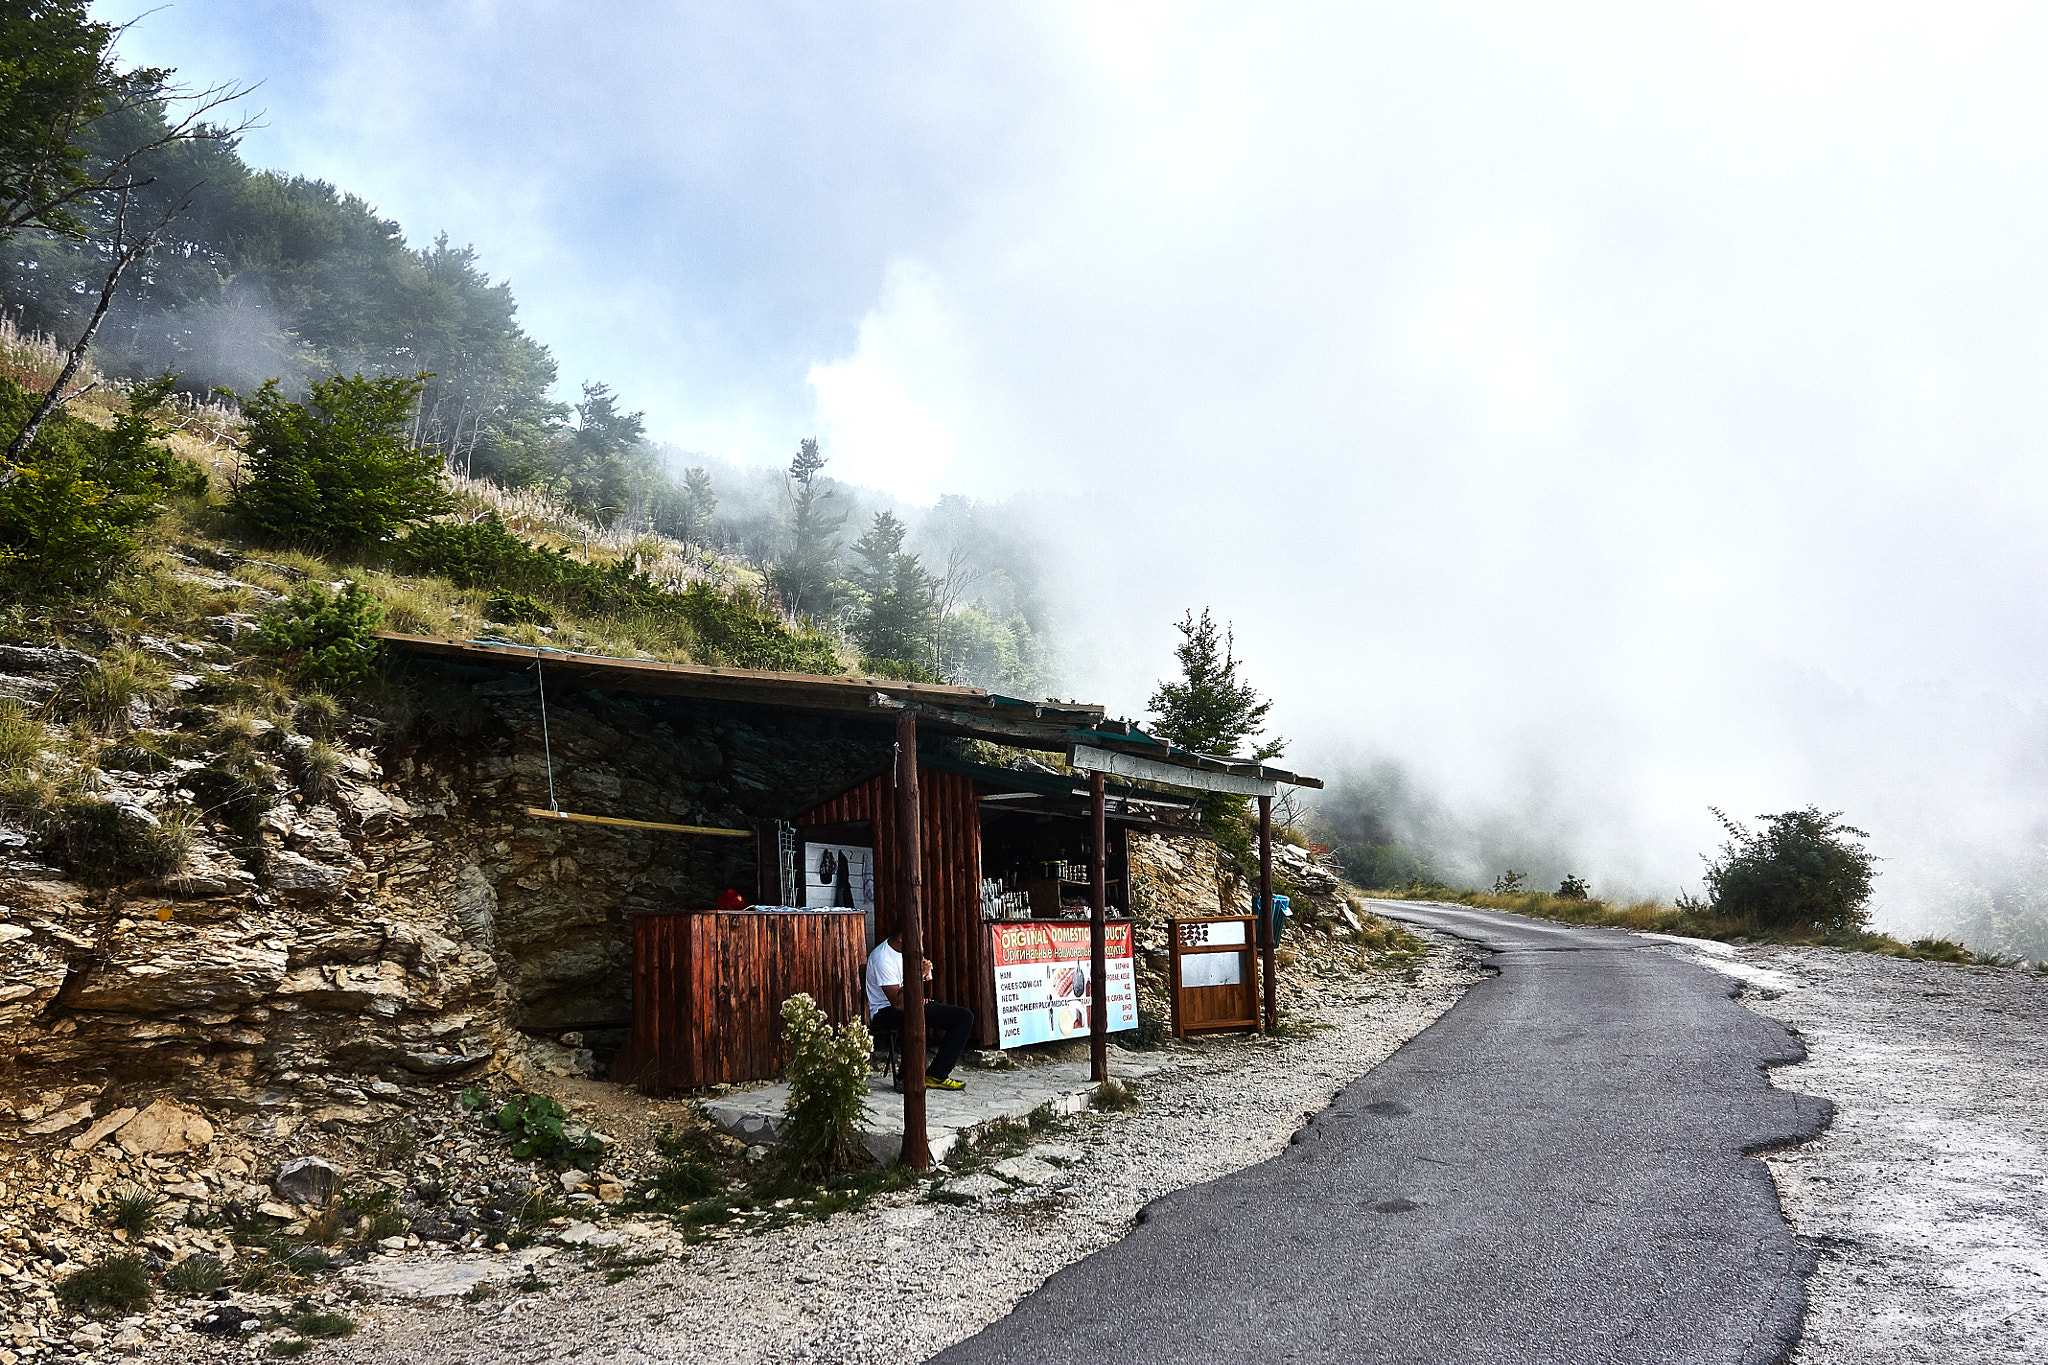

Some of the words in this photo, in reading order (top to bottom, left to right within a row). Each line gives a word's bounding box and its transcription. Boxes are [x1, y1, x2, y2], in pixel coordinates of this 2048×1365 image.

[1051, 927, 1090, 942] DOMESTIC
[1104, 926, 1127, 941] DUCTS
[999, 971, 1012, 980] HAM
[1002, 1016, 1018, 1026] WINE
[1004, 1027, 1020, 1038] JUICE
